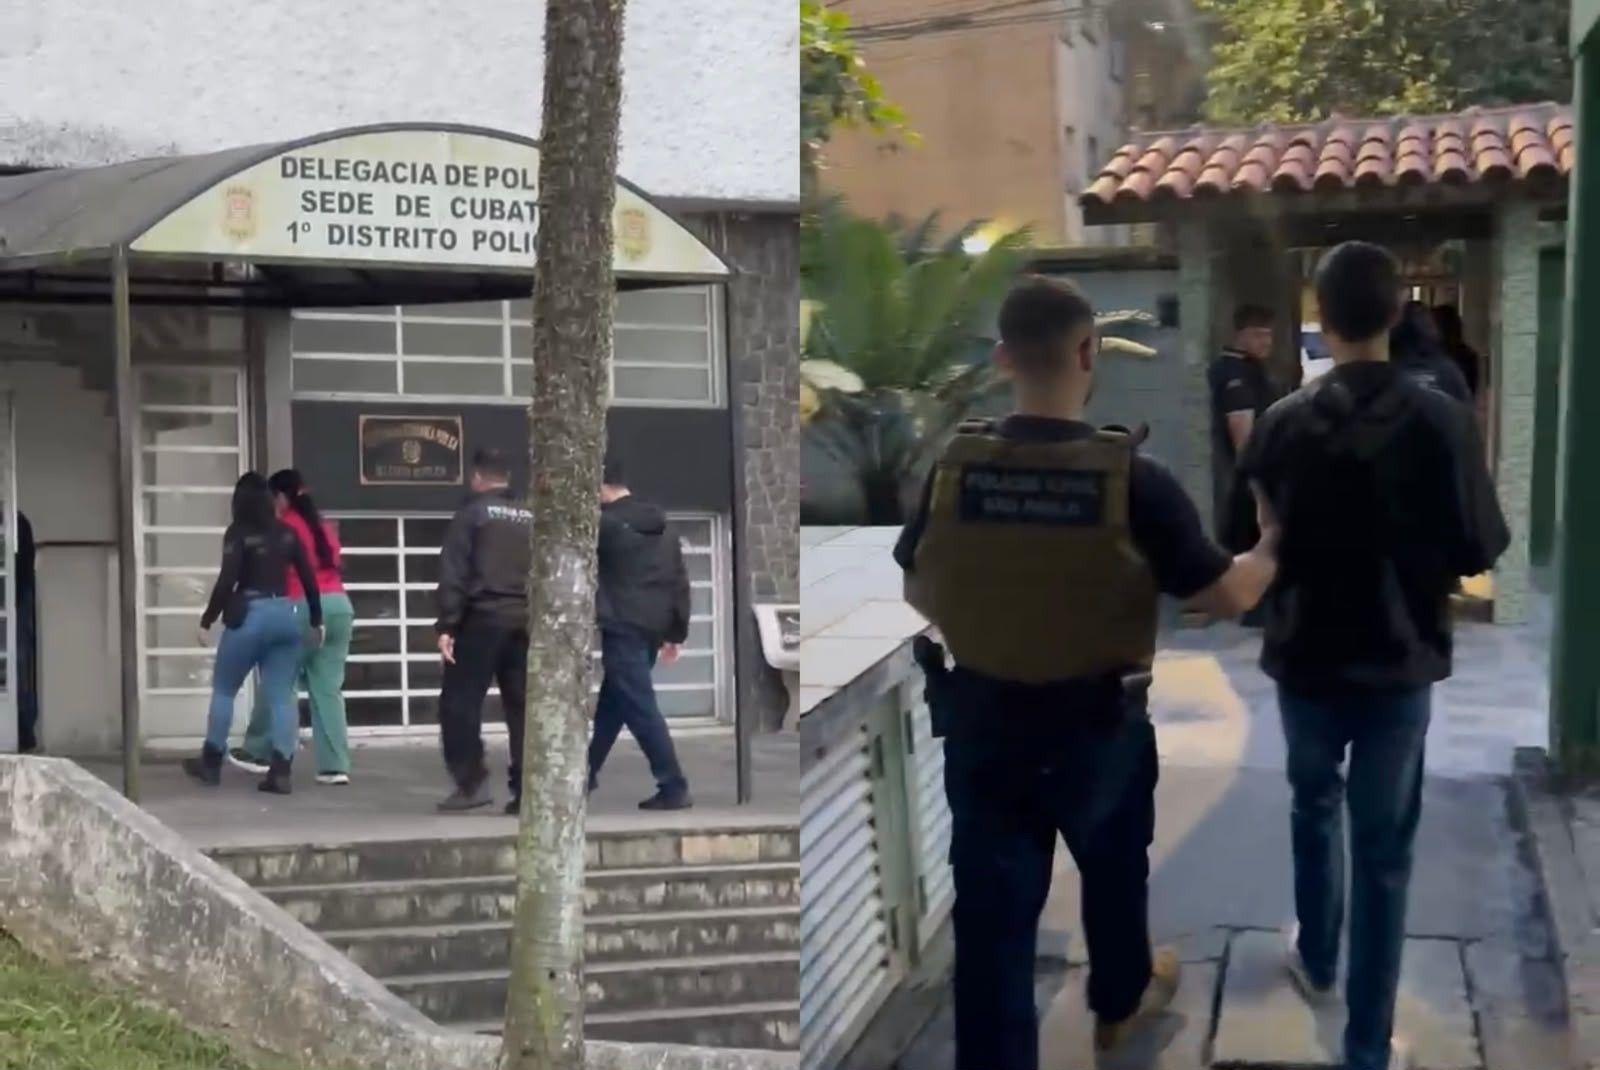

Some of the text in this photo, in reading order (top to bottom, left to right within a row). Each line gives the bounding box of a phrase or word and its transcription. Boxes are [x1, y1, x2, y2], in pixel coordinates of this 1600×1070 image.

[280, 157, 535, 190] DELEGACIA DE POL
[301, 190, 540, 222] SEDE DE CUBAT
[328, 224, 457, 251] DISTRITO
